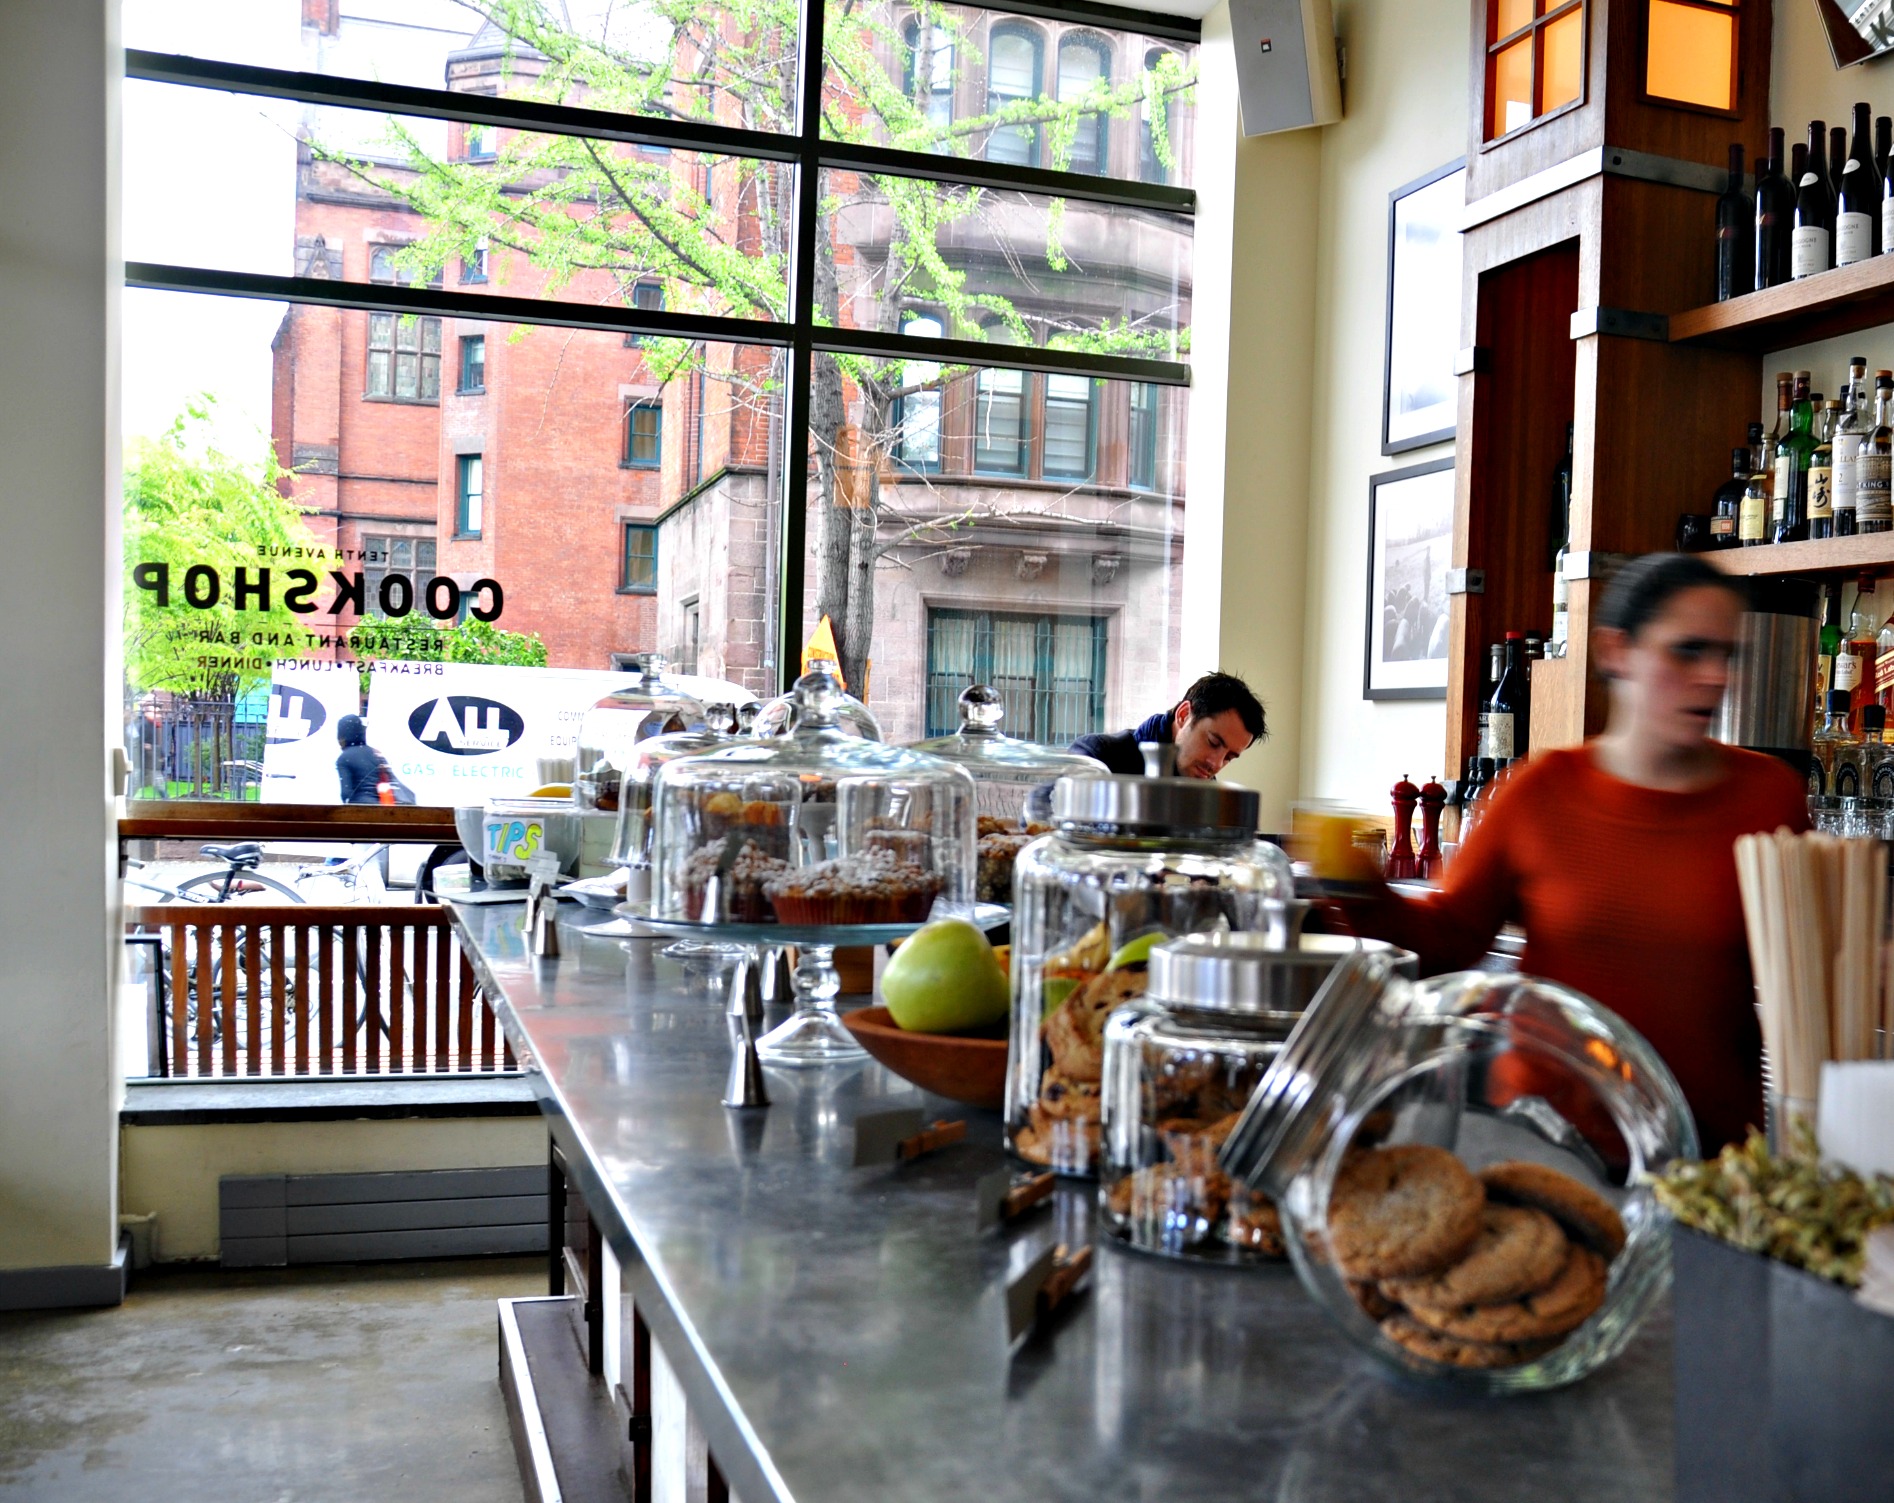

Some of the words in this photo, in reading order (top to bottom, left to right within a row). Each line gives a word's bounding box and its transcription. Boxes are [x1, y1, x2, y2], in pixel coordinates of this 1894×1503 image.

[550, 735, 577, 747] EQUIP
[402, 763, 435, 775] GAS
[453, 764, 524, 778] ELECTRIC
[487, 821, 543, 860] TIPS
